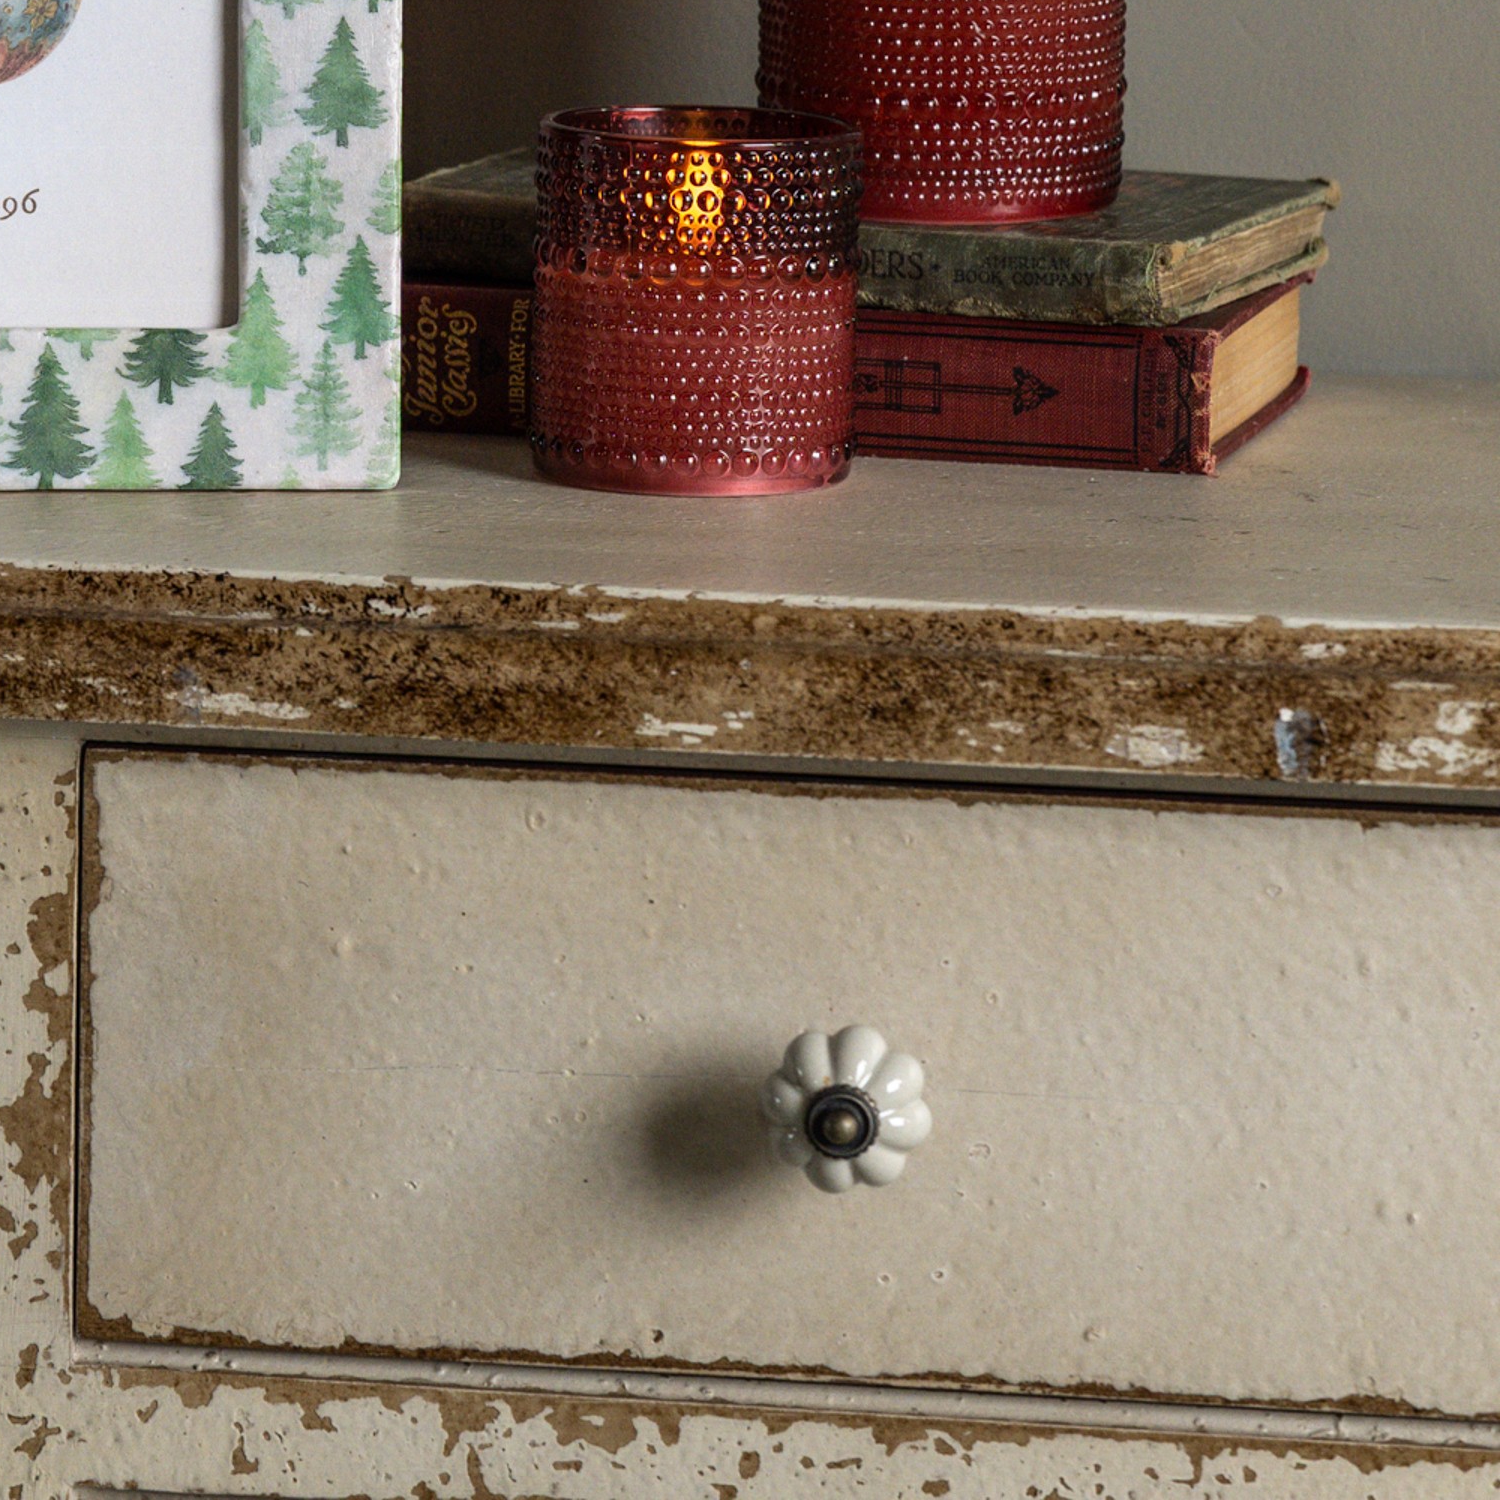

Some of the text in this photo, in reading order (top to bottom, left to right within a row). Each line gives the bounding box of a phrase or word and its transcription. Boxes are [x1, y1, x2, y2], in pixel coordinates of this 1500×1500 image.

[981, 255, 1070, 270] AMERICAN
[953, 268, 1096, 288] BOOK COMPANY
[403, 295, 445, 425] Junior
